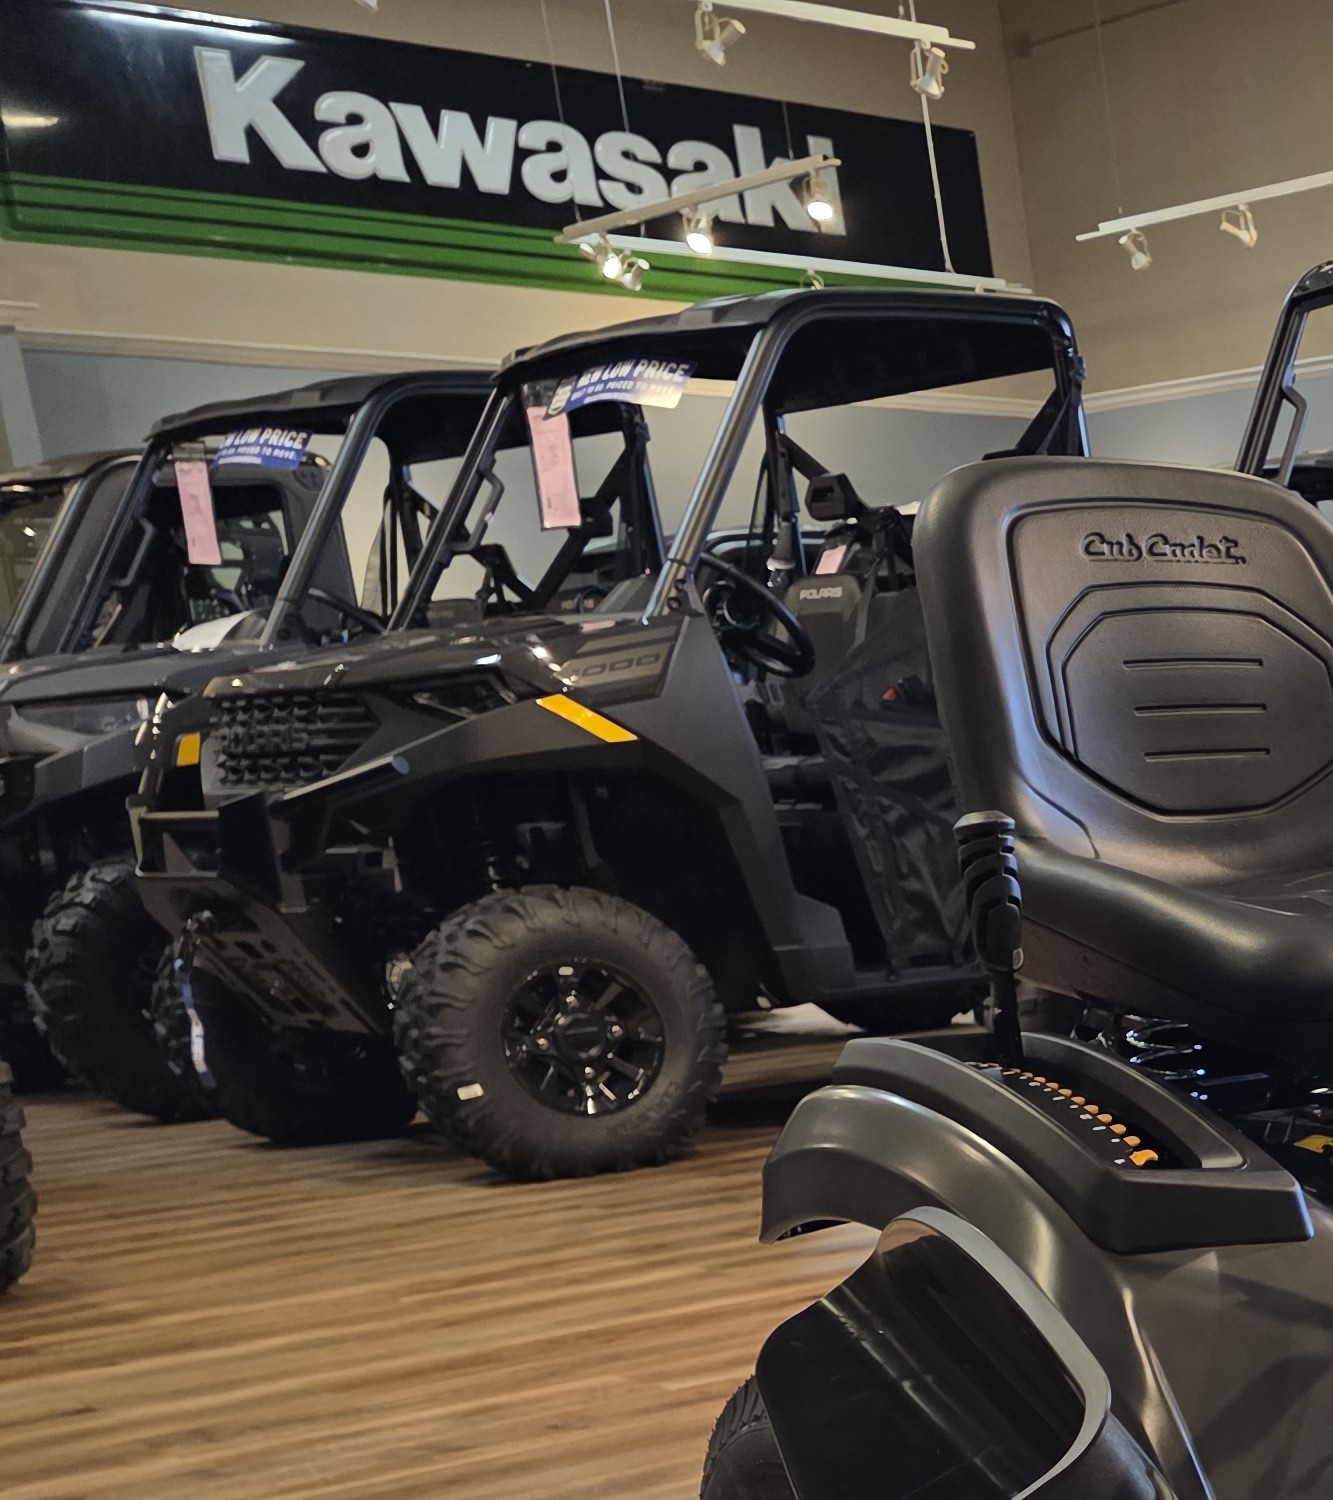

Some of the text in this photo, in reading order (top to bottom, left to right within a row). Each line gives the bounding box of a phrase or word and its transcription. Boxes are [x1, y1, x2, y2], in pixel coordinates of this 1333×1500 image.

[633, 359, 689, 382] PRICE
[259, 427, 308, 450] PRICE
[1079, 532, 1143, 562] Cub
[800, 586, 843, 600] POLARIS
